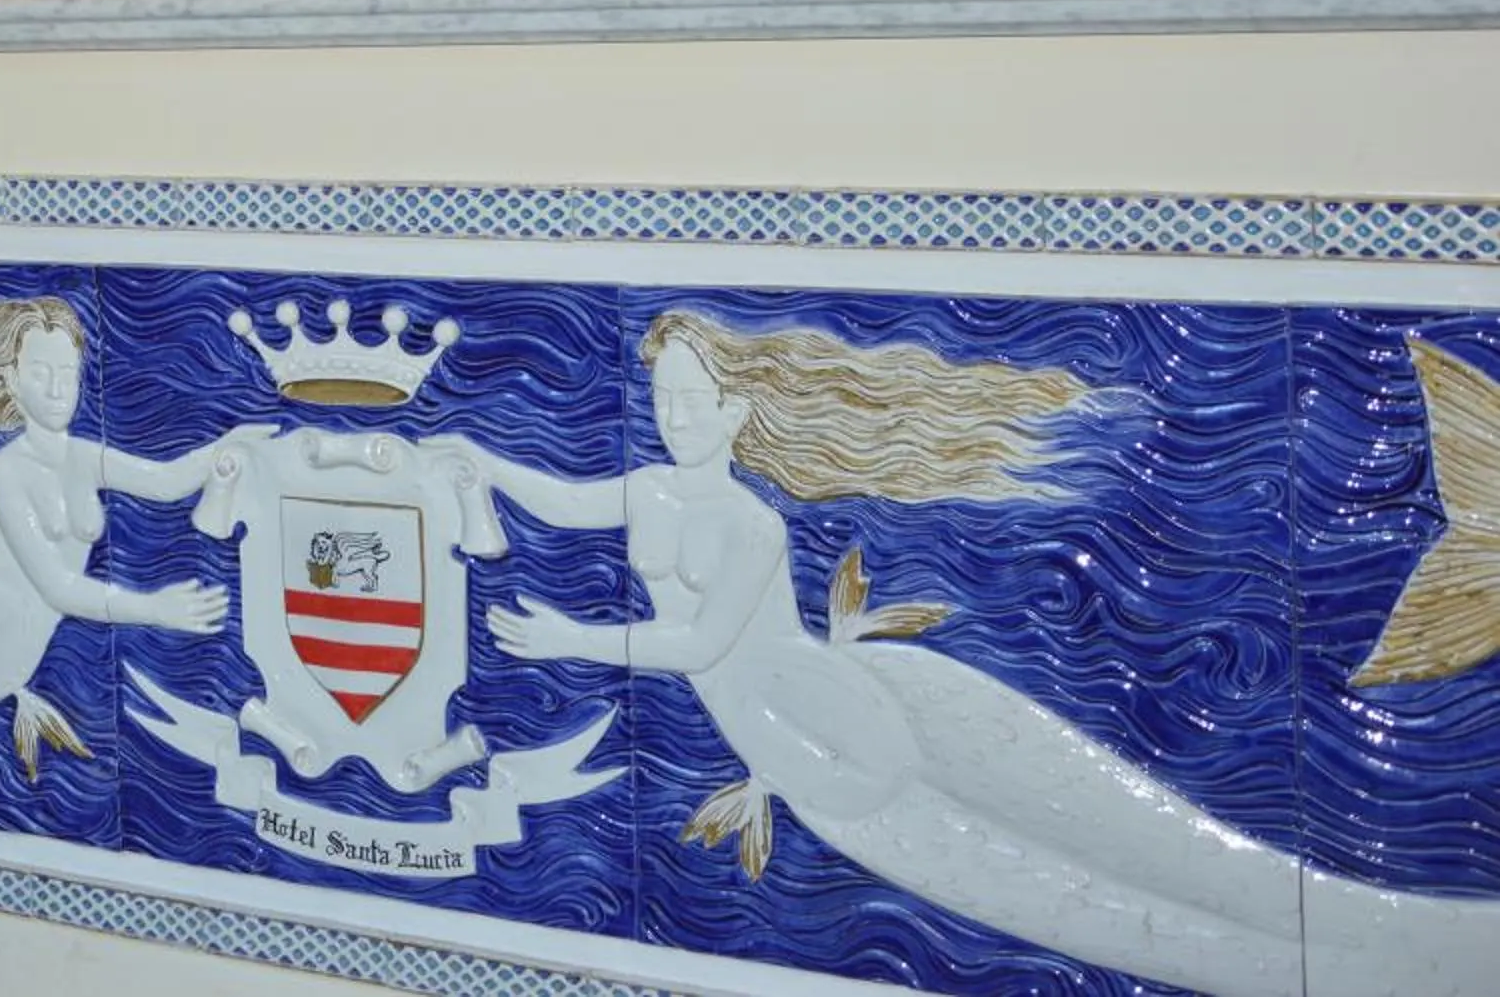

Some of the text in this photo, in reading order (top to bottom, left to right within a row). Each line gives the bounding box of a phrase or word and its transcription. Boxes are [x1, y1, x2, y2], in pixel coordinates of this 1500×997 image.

[261, 809, 464, 870] Hotel Santa Lucia
